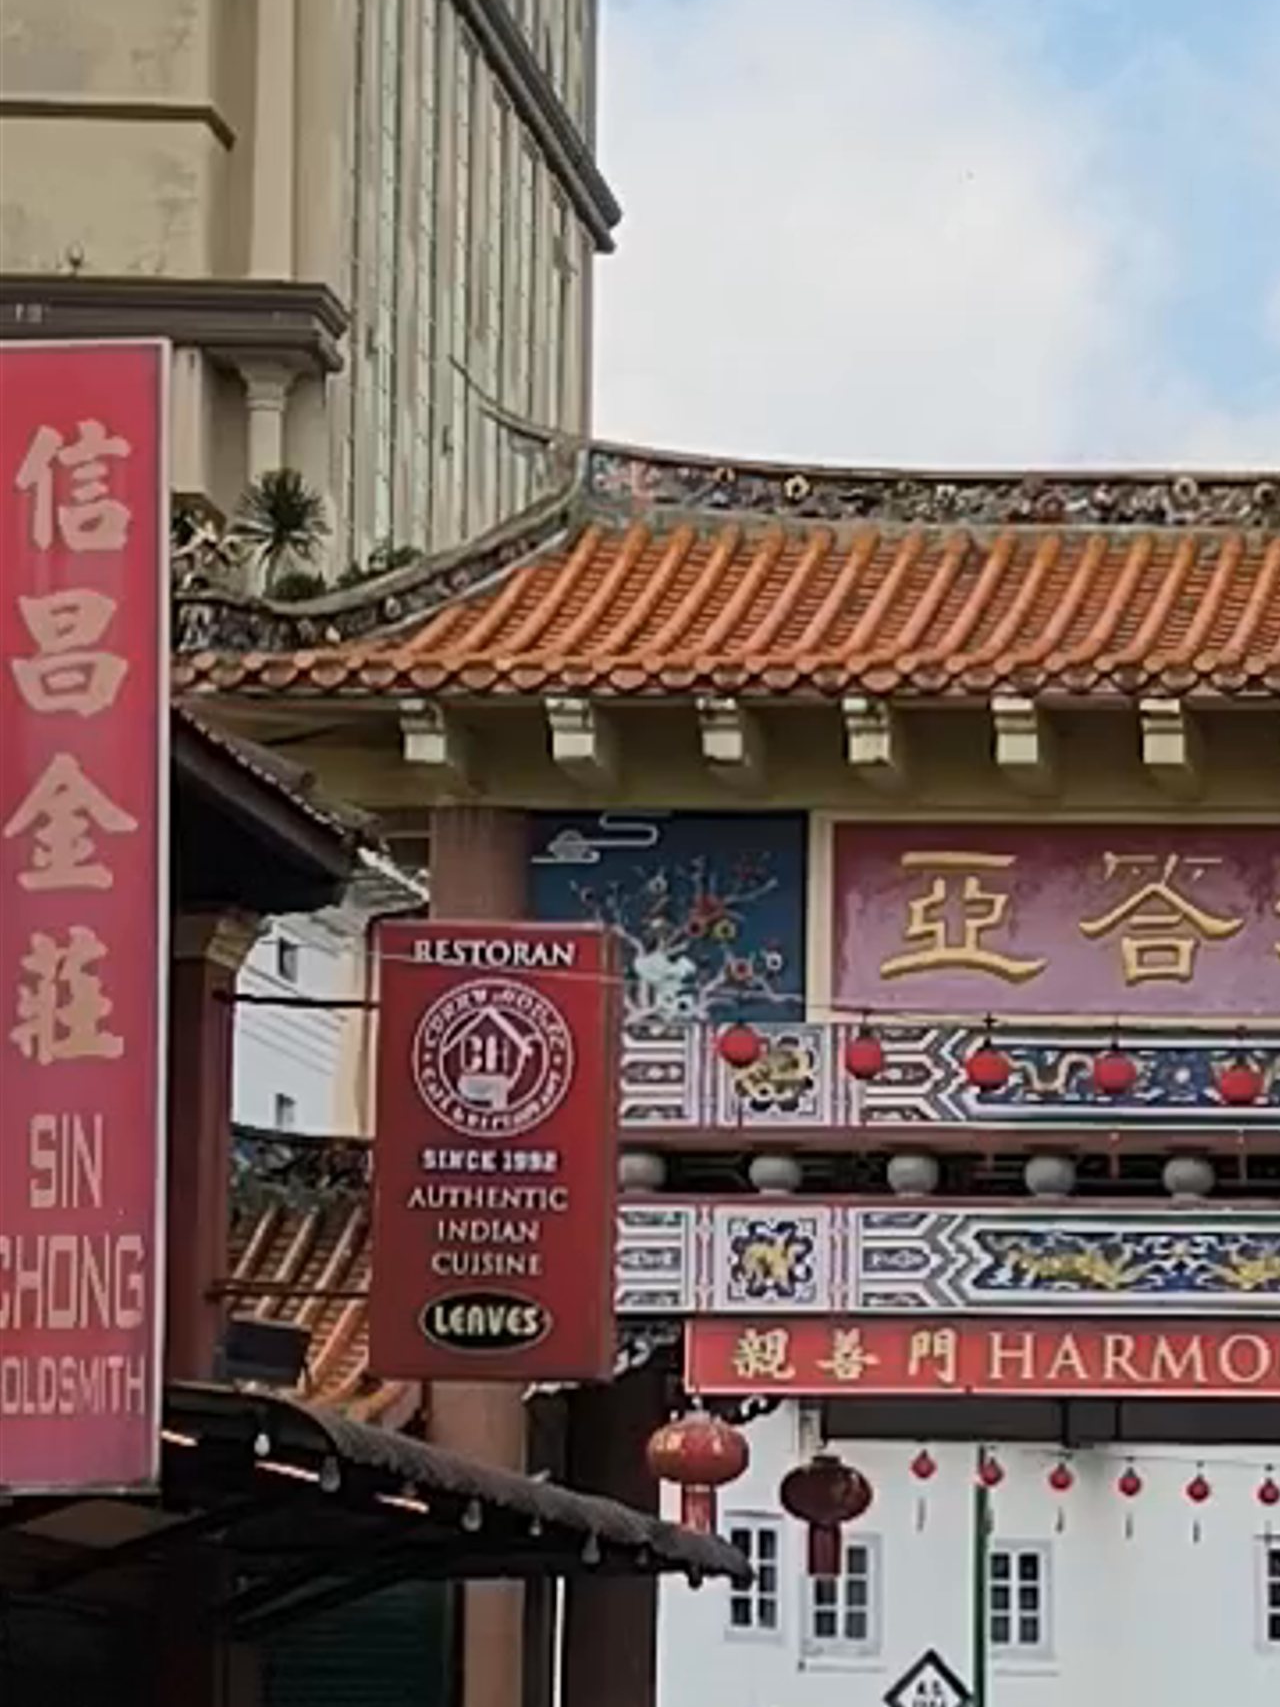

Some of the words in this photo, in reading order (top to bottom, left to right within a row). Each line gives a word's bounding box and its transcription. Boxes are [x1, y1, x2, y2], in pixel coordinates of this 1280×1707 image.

[3, 419, 138, 1066] 信昌金莊
[413, 939, 576, 967] RESTORAN
[28, 1113, 104, 1209] SIN
[422, 1149, 497, 1172] SINCE
[407, 1185, 569, 1211] AUTHENTIC
[438, 1218, 540, 1243] INDIAN
[431, 1251, 543, 1276] CUISINE
[433, 1305, 540, 1336] LEAVES
[0, 1355, 146, 1415] OLDSMITH
